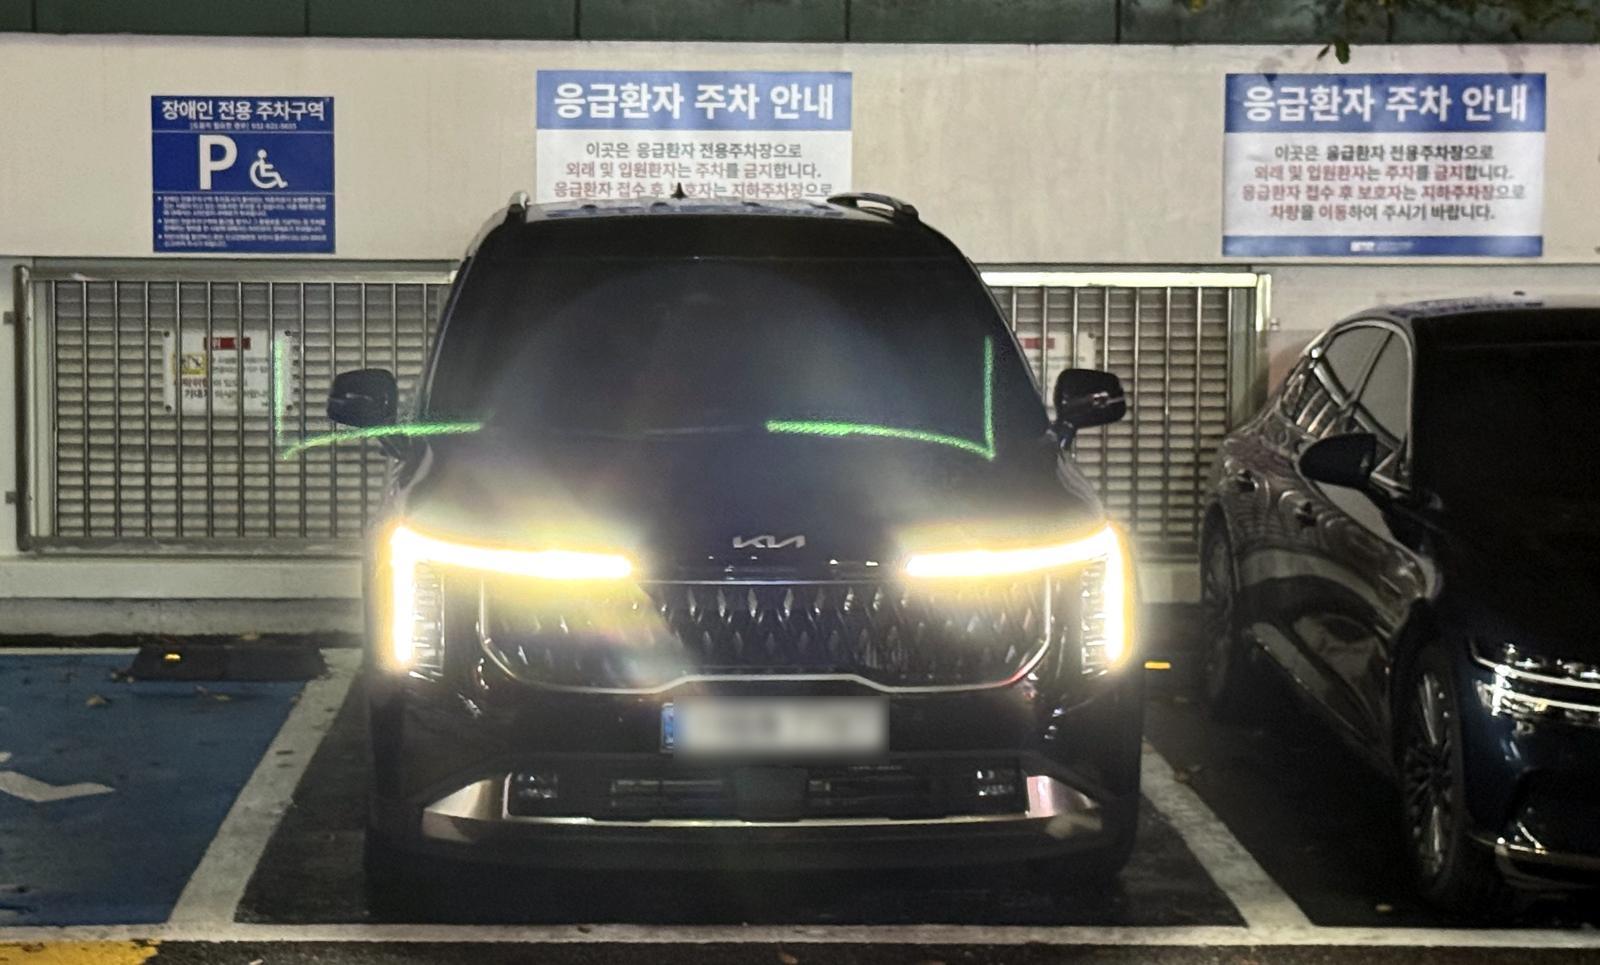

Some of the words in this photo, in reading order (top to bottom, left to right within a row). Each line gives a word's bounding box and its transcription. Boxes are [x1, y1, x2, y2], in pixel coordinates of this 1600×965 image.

[162, 100, 213, 121] 장애인
[218, 100, 253, 121] 전용
[256, 101, 324, 121] 주차구역
[554, 83, 684, 119] 응급환자
[695, 83, 760, 120] 주차
[770, 83, 834, 120] 안내
[1243, 85, 1375, 122] 응급환자
[1386, 85, 1451, 122] 주차
[1462, 85, 1527, 122] 안내
[586, 143, 631, 159] 이곳은
[637, 143, 695, 159] 응급환자
[700, 143, 802, 159] 전용주차장으로
[1275, 144, 1318, 161] 이곳은
[1326, 144, 1385, 161] 응급환자
[1390, 144, 1493, 161] 전용주차장으로
[199, 134, 238, 190] P
[566, 161, 595, 179] 외래
[600, 161, 613, 179] 및
[618, 161, 692, 179] 입원환자는
[696, 162, 739, 179] 주차를
[744, 162, 822, 179] 금지합니다.
[1255, 164, 1284, 182] 외래
[1289, 164, 1303, 182] 및
[1306, 164, 1381, 182] 입원환자는
[1385, 164, 1430, 182] 주차를
[1434, 164, 1515, 182] 금지합니다.
[554, 182, 612, 199] 응급환자
[617, 182, 648, 199] 접수
[650, 182, 664, 199] 후
[669, 182, 727, 199] 호자는
[732, 182, 833, 199] 지하주차장으로
[1243, 184, 1301, 202] 응급환자
[1306, 184, 1336, 202] 접수
[1339, 184, 1353, 202] 후
[1358, 184, 1418, 202] 보호자는
[1421, 184, 1526, 202] 지하주차장으로
[1270, 204, 1314, 222] 차량을
[1319, 204, 1378, 222] 이동하여
[1382, 204, 1428, 222] 주시기
[1431, 204, 1496, 222] 바랍니다.
